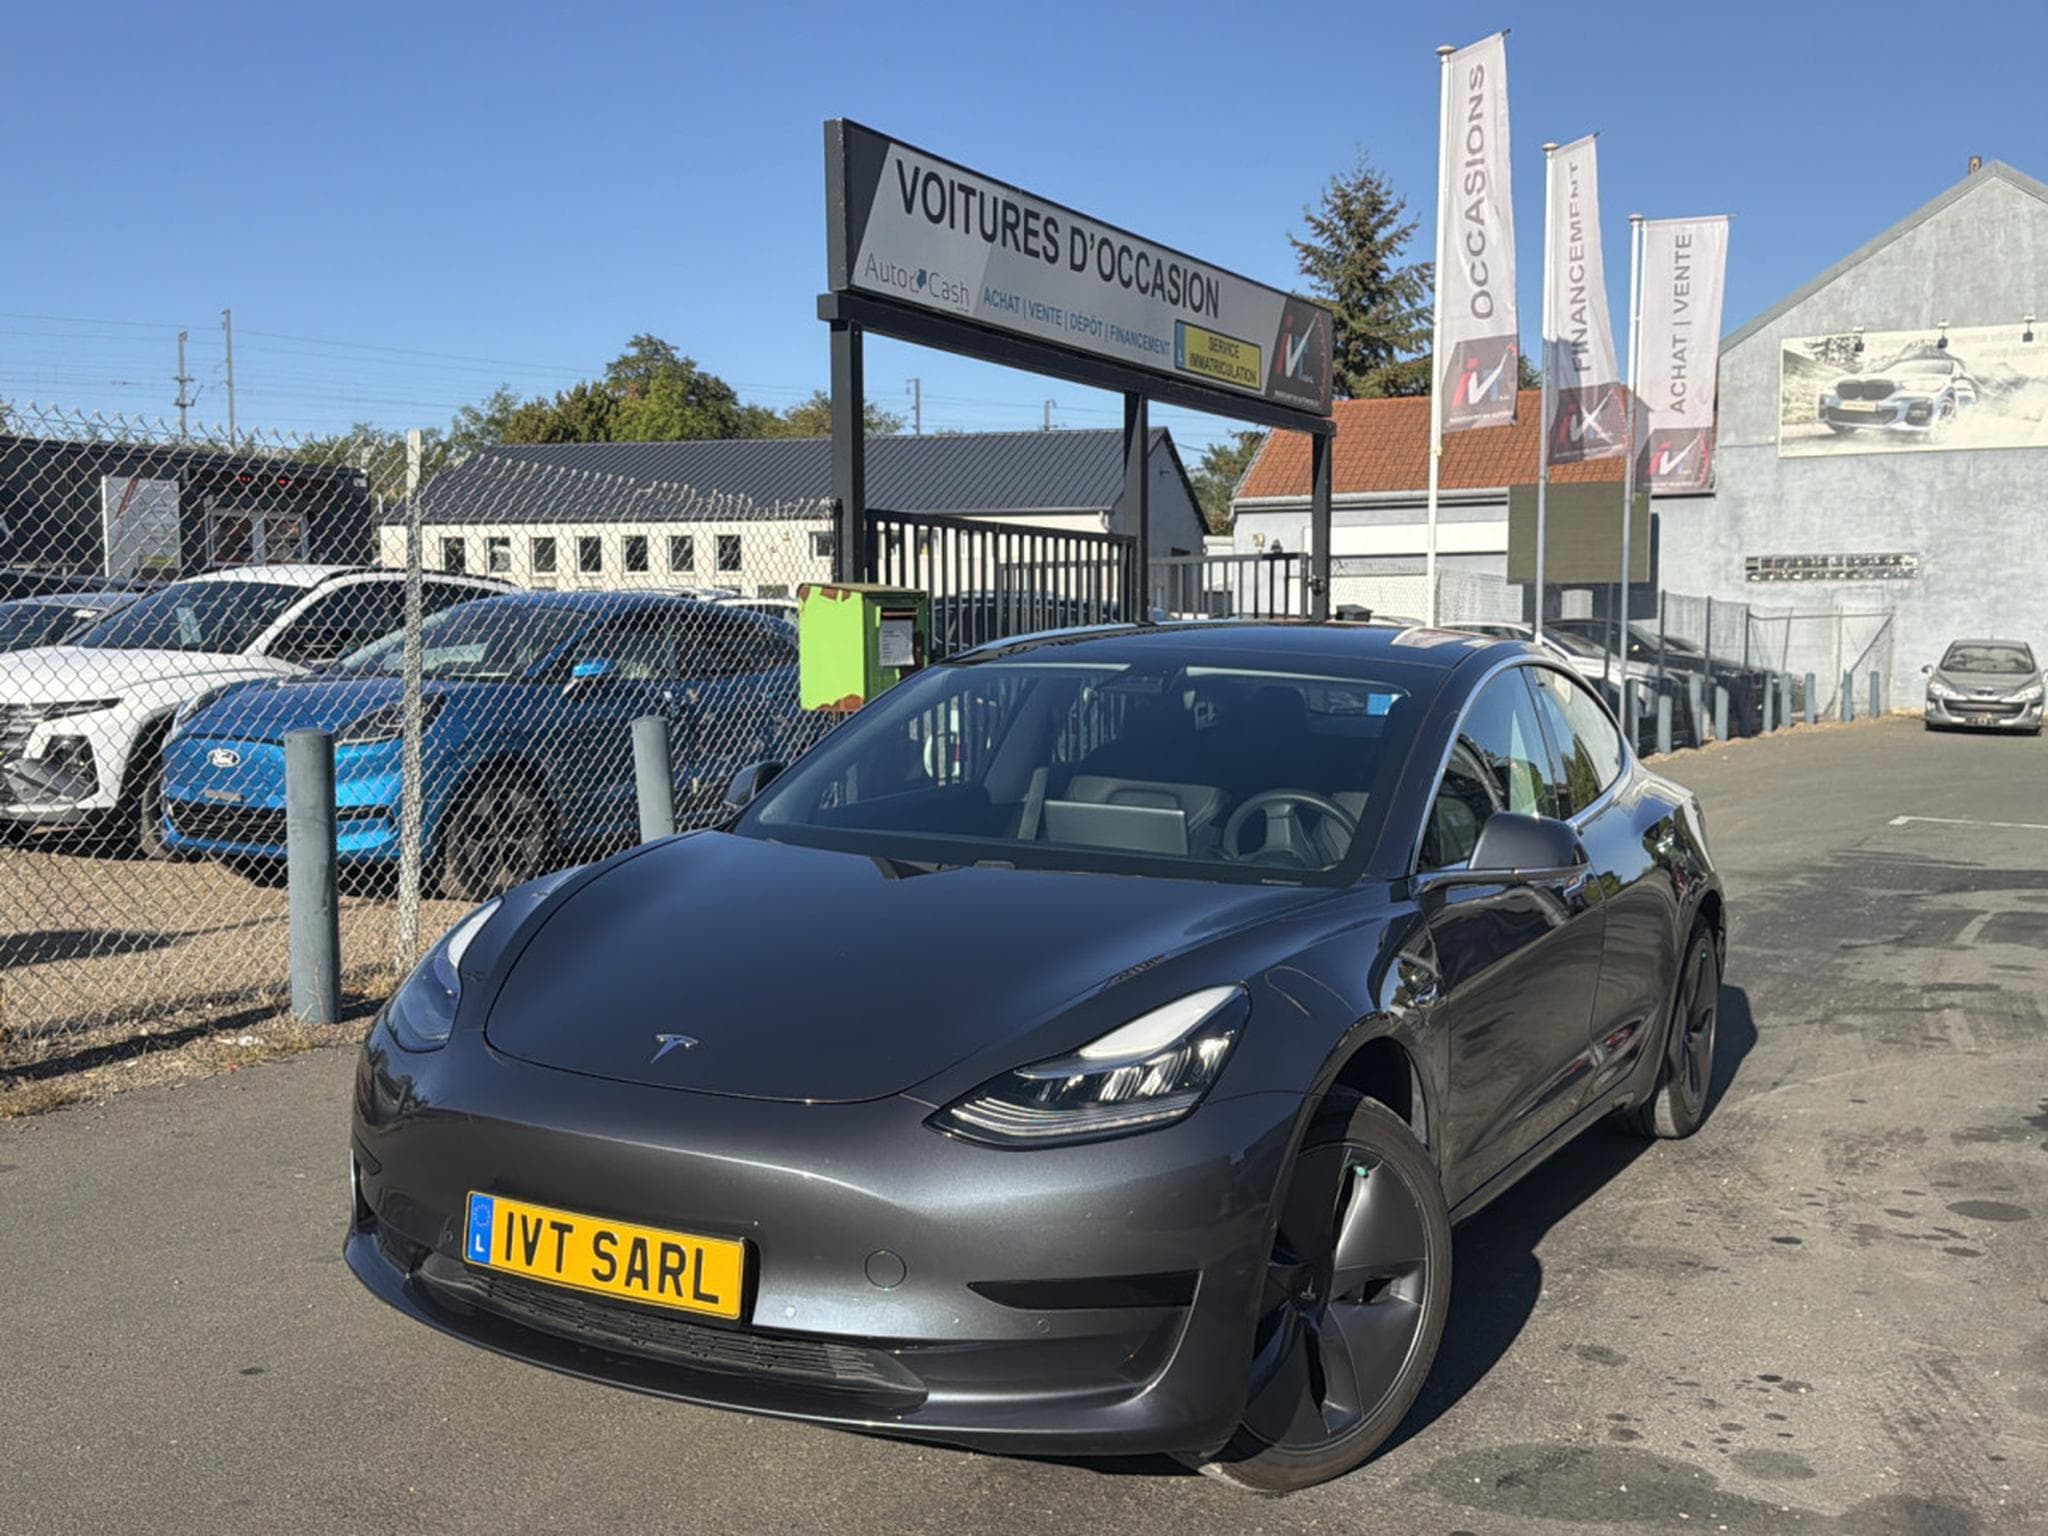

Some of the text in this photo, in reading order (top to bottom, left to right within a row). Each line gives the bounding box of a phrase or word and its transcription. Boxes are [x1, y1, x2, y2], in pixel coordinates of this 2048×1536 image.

[1464, 64, 1494, 319] OCCASIONS
[897, 159, 1219, 319] VOITURES D'OCCASION
[984, 287, 1171, 355] ACHAT VENTE DÉPÔT FINANCEMENT
[1208, 336, 1240, 360] SERVICE
[1670, 234, 1692, 414] ACHAT VENTE
[474, 1234, 485, 1253] L
[505, 1211, 719, 1305] IVT SARL
